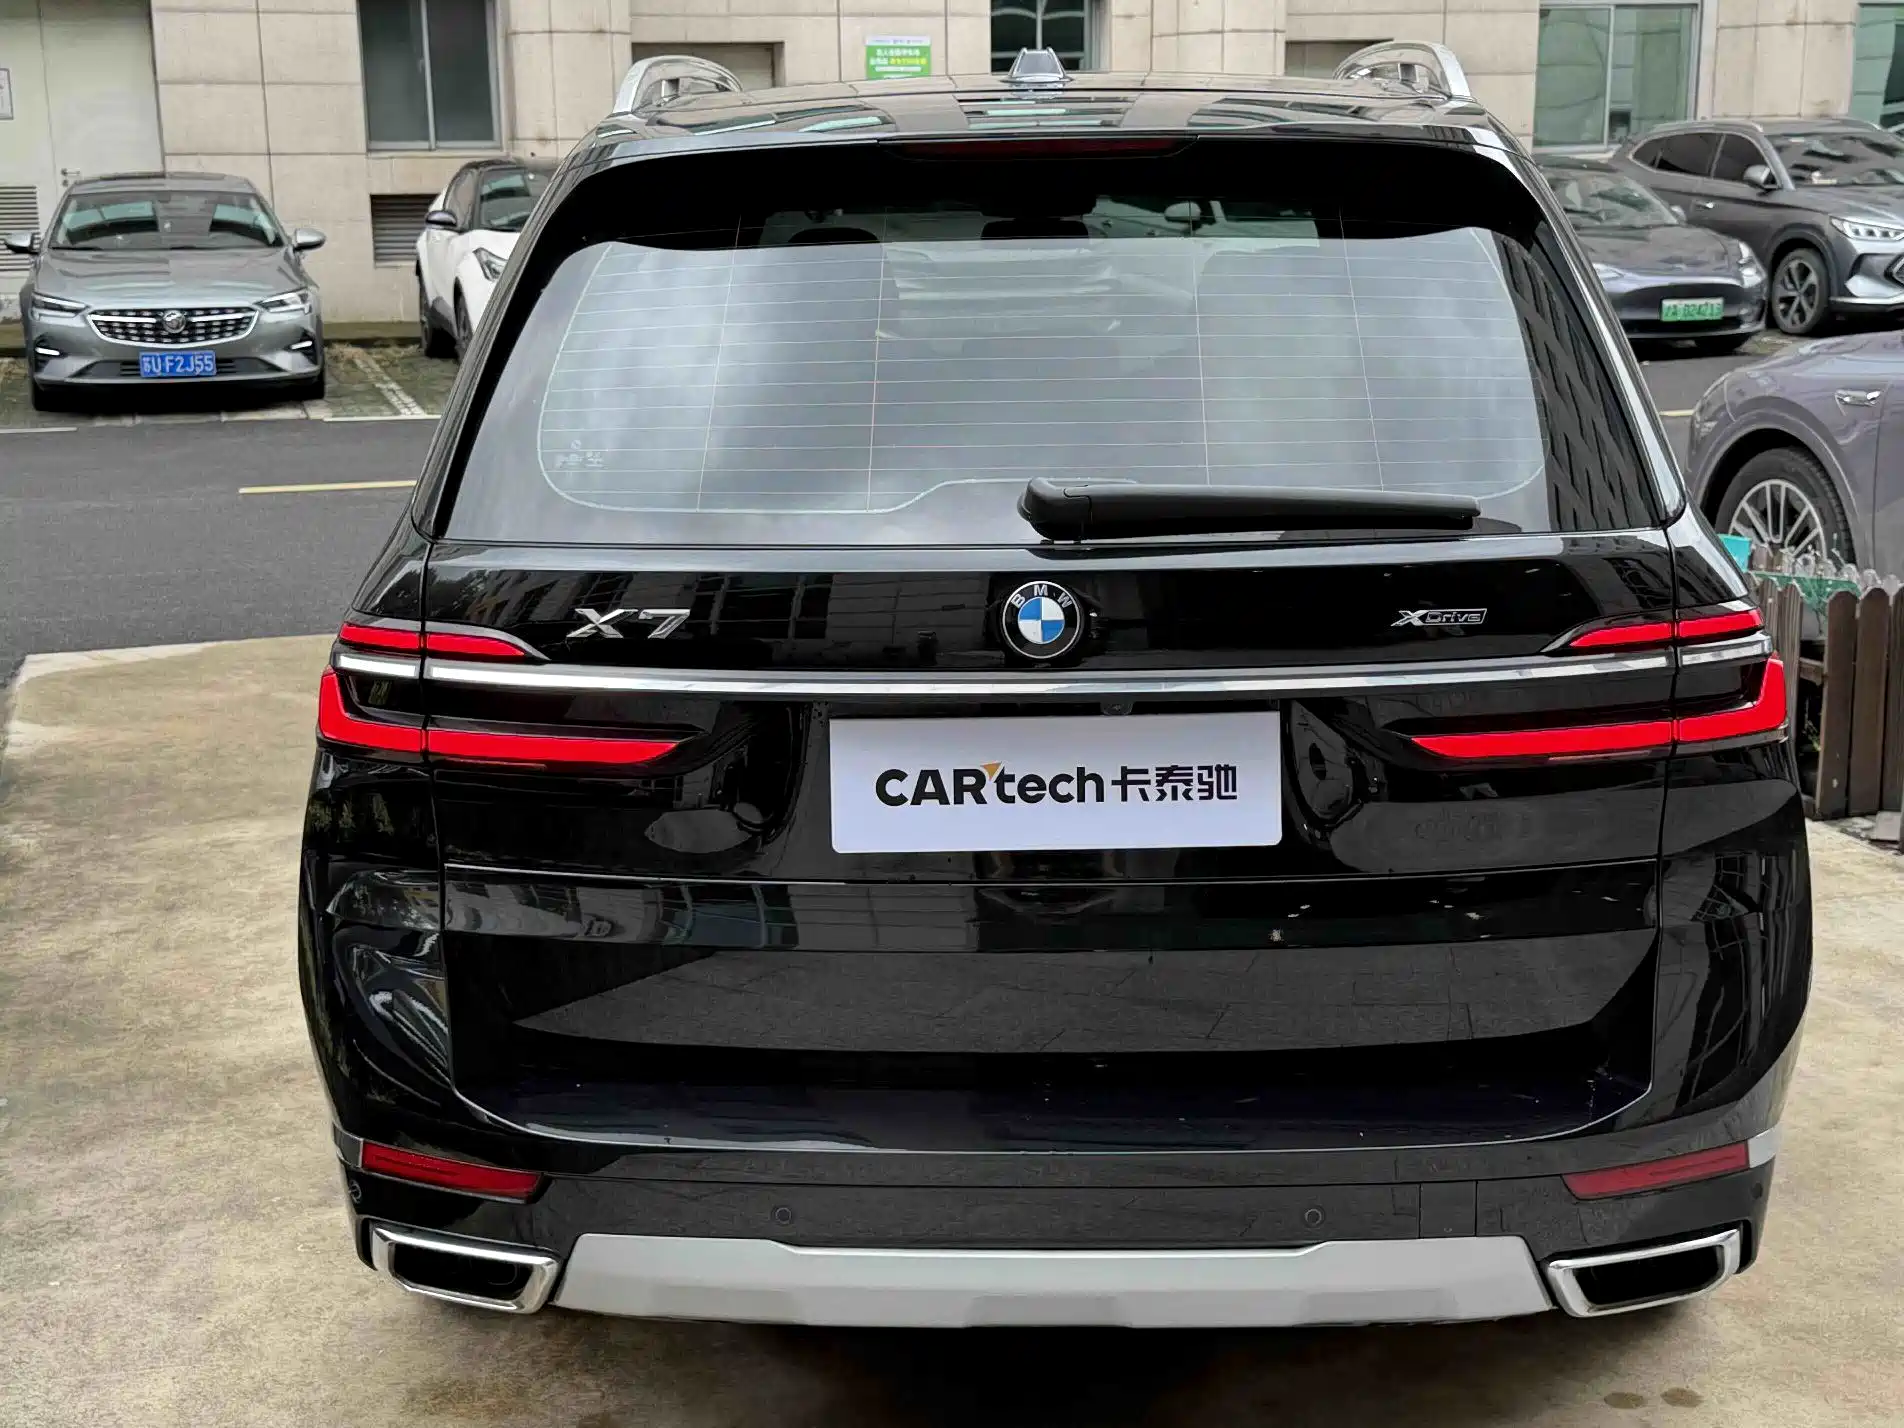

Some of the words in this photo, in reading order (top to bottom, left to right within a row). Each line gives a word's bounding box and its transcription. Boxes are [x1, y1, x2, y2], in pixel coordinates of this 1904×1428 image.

[1010, 584, 1073, 609] BMW
[566, 608, 691, 640] X7
[1111, 764, 1238, 803] 卡泰驰
